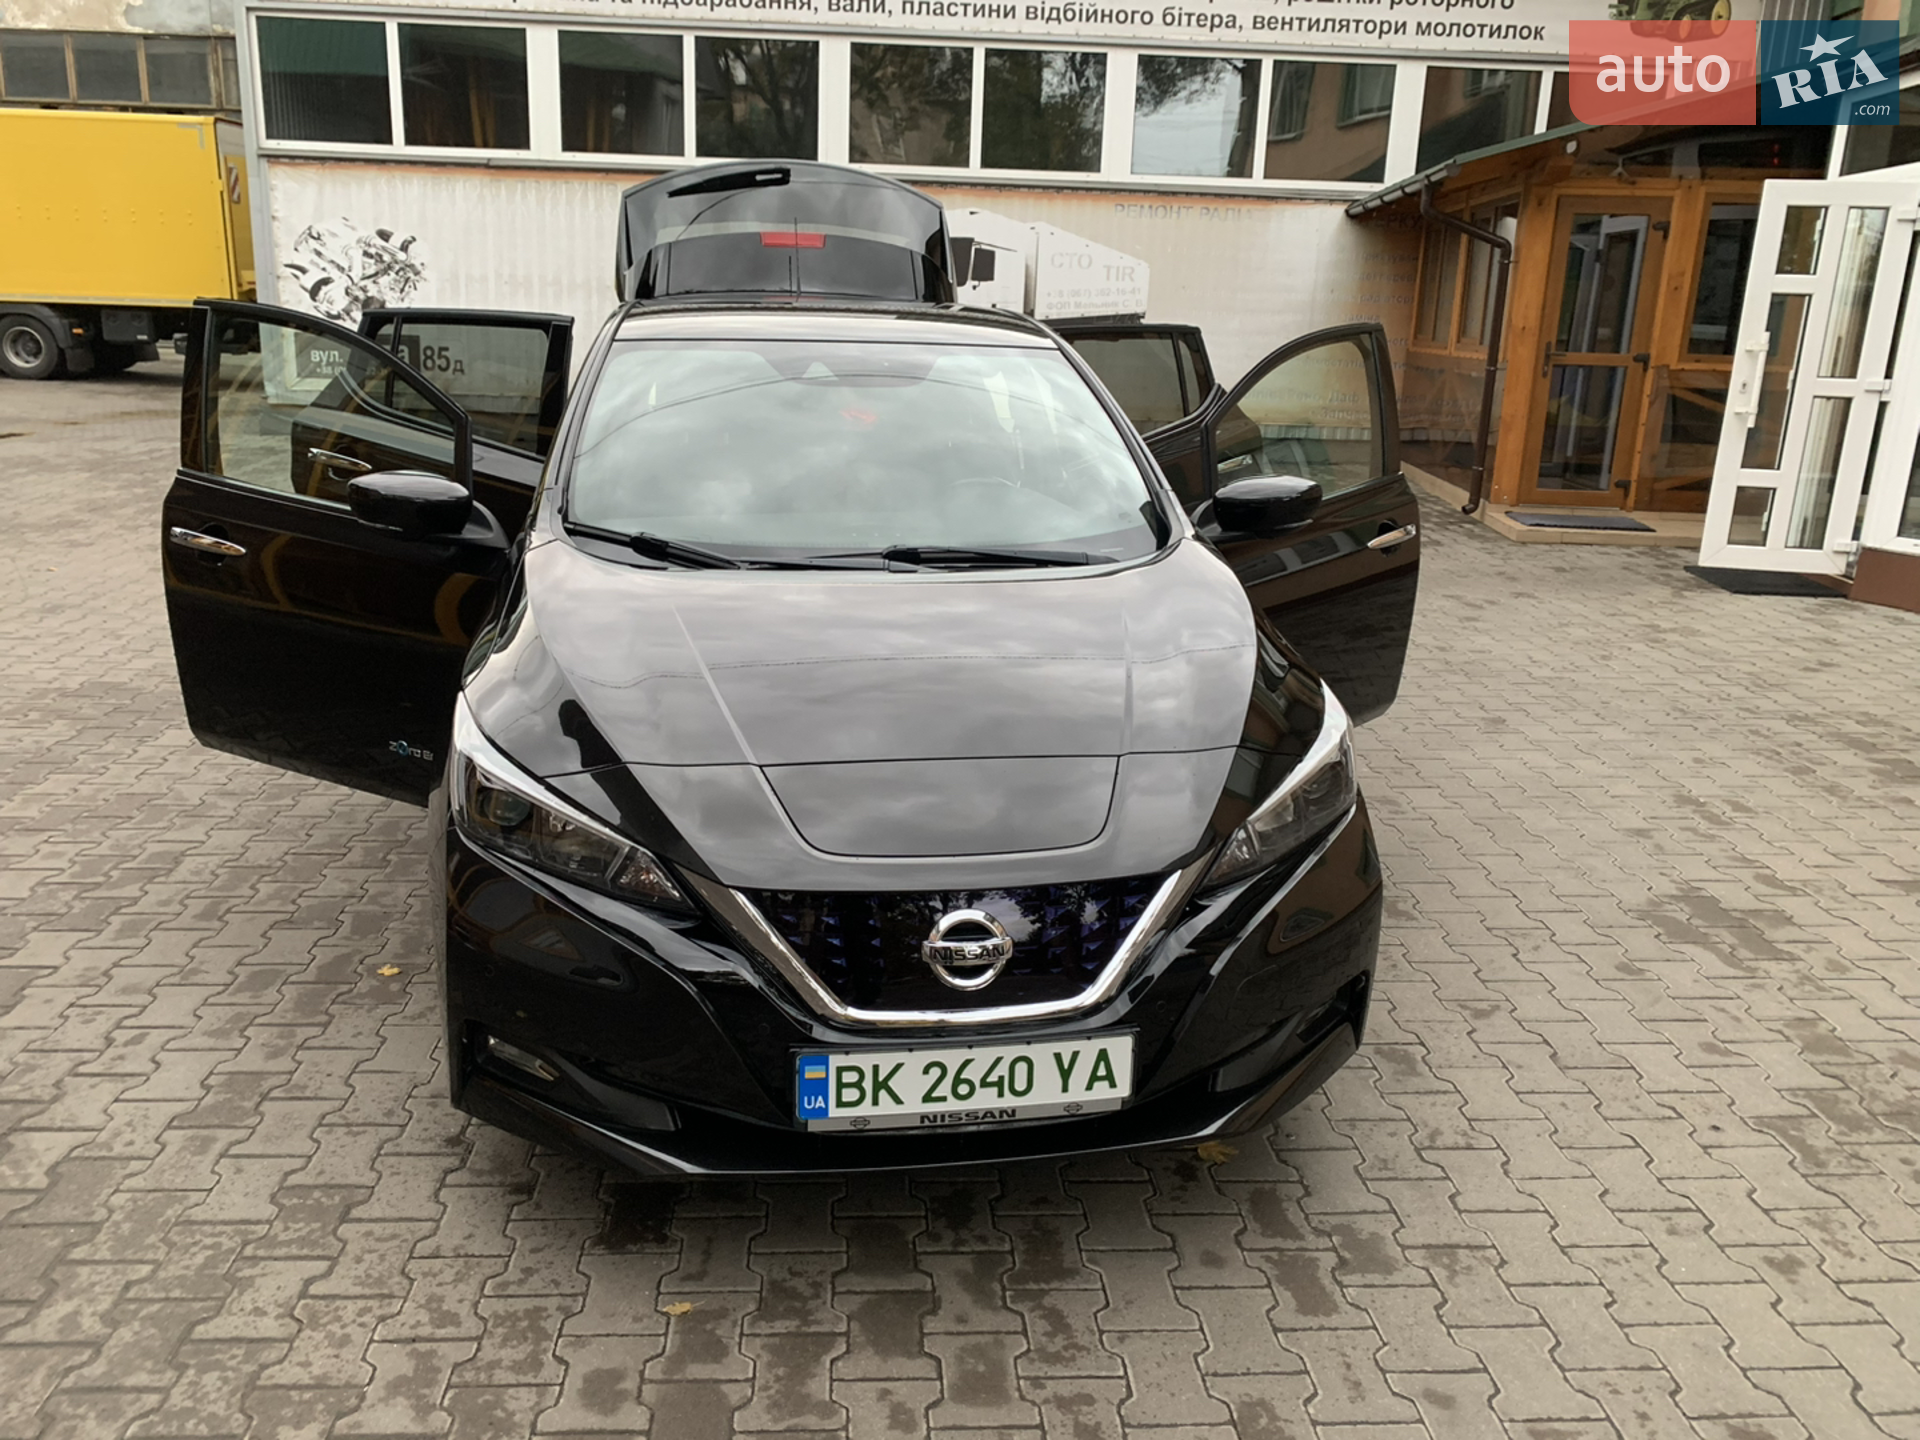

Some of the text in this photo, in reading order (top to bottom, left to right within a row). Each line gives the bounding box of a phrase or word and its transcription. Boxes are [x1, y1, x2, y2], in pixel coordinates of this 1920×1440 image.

[827, 0, 893, 17] вали,
[901, 0, 1016, 20] пластини
[1025, 2, 1154, 25] відбійного
[1162, 7, 1244, 32] бітера,
[1251, 15, 1407, 39] вентилятори
[1414, 20, 1546, 41] молотилок
[1050, 251, 1093, 270] СТО
[1102, 264, 1136, 282] TIR
[310, 350, 344, 363] вул.
[929, 944, 1005, 962] NISSAN
[835, 1047, 1118, 1109] BK 2640 YA
[803, 1095, 826, 1110] UA
[919, 1107, 1017, 1125] NISSAN
